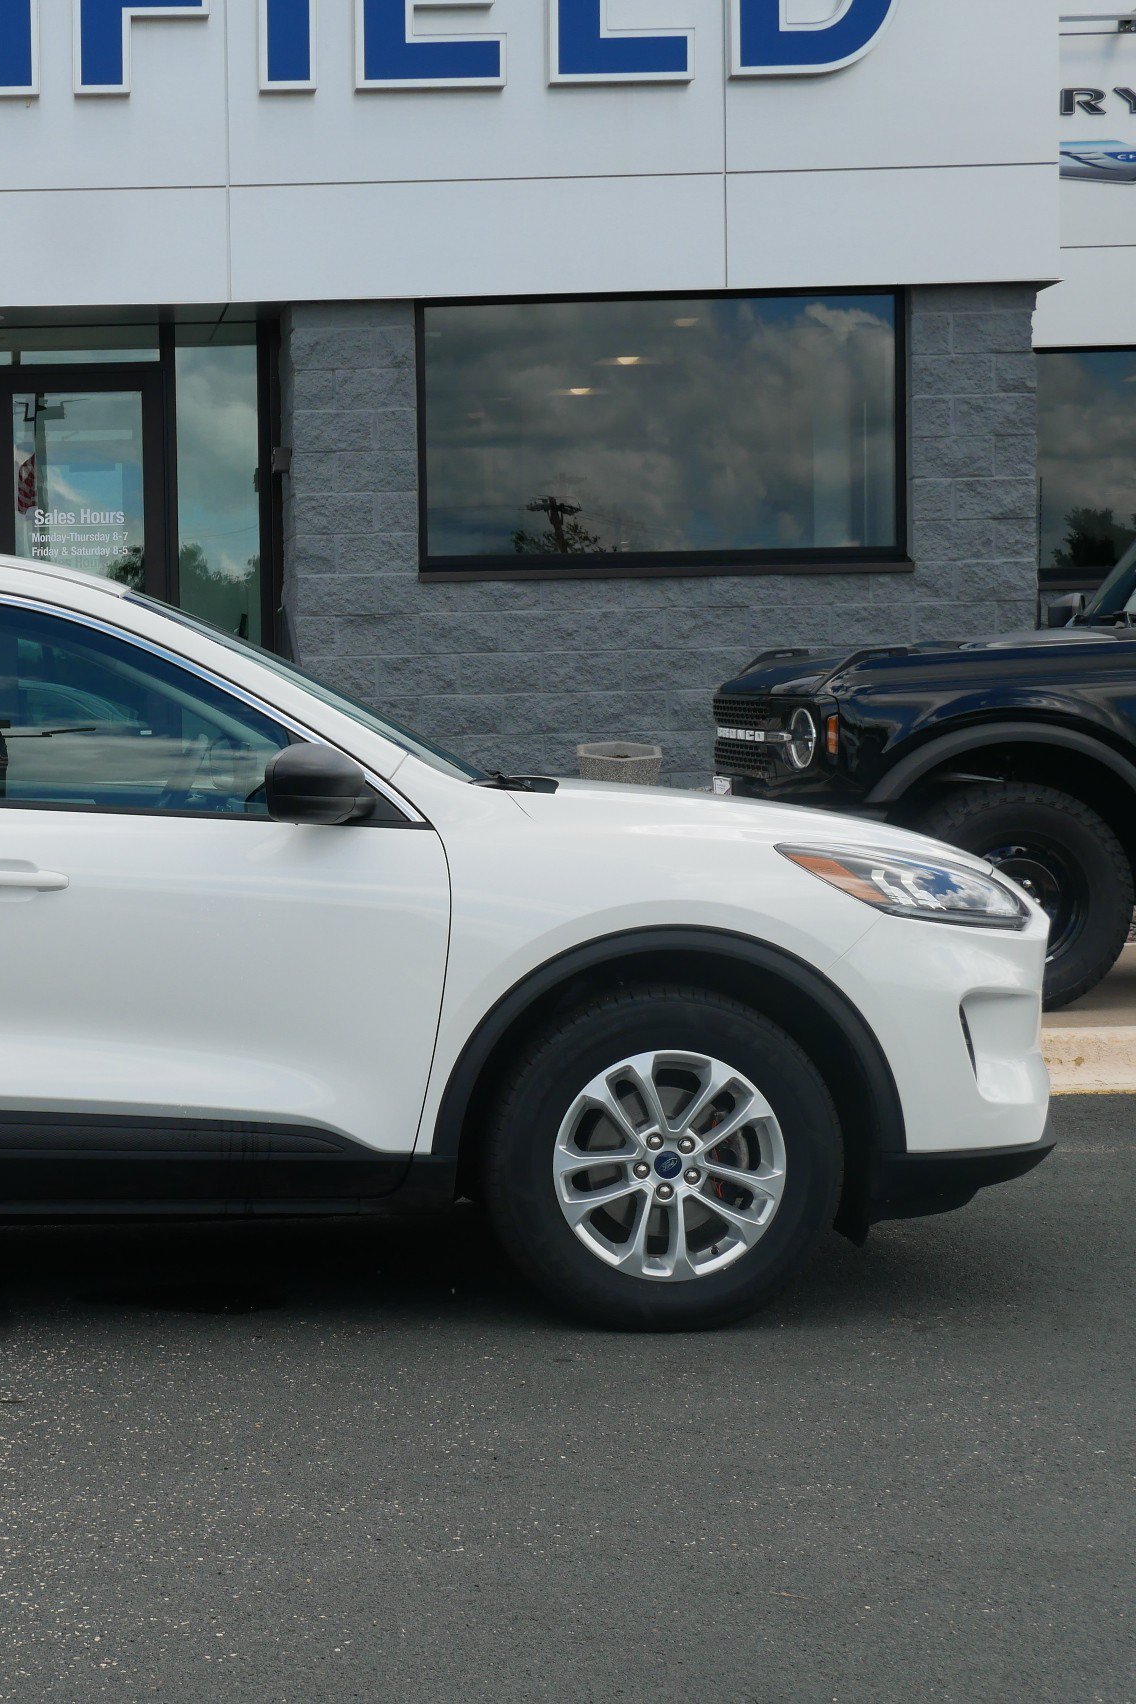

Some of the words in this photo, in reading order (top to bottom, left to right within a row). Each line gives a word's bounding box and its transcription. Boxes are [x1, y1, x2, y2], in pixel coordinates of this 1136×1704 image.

[34, 509, 75, 525] Sales
[80, 509, 124, 524] Hours
[31, 532, 110, 543] Monday-Thursday
[112, 531, 129, 541] 8-7
[31, 547, 59, 558] Friday
[61, 546, 68, 556] &
[71, 546, 110, 557] Saturday
[112, 545, 128, 555] 8-5
